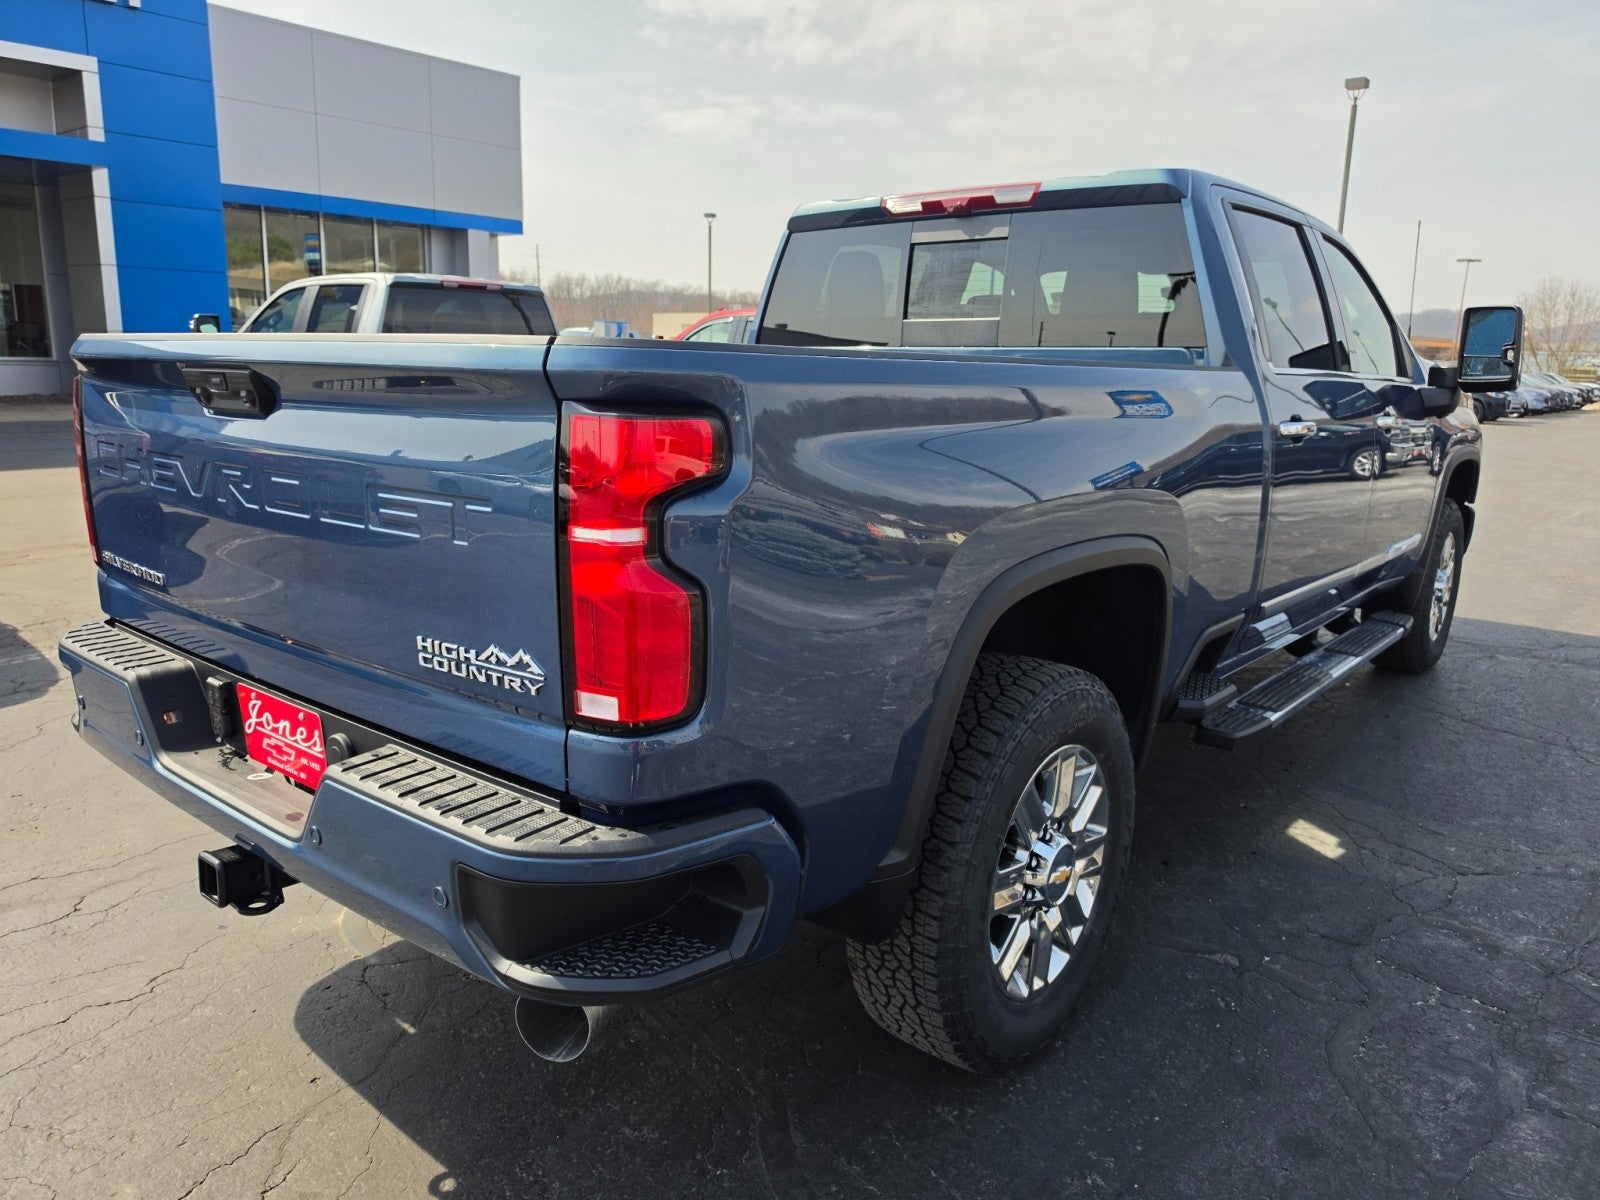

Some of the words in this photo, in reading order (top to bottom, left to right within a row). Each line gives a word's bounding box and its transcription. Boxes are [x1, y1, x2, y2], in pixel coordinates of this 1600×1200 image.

[96, 439, 493, 546] CHEVROLET
[416, 635, 477, 663] HIGH
[418, 651, 545, 696] COUNTRY
[245, 699, 323, 752] Jones
